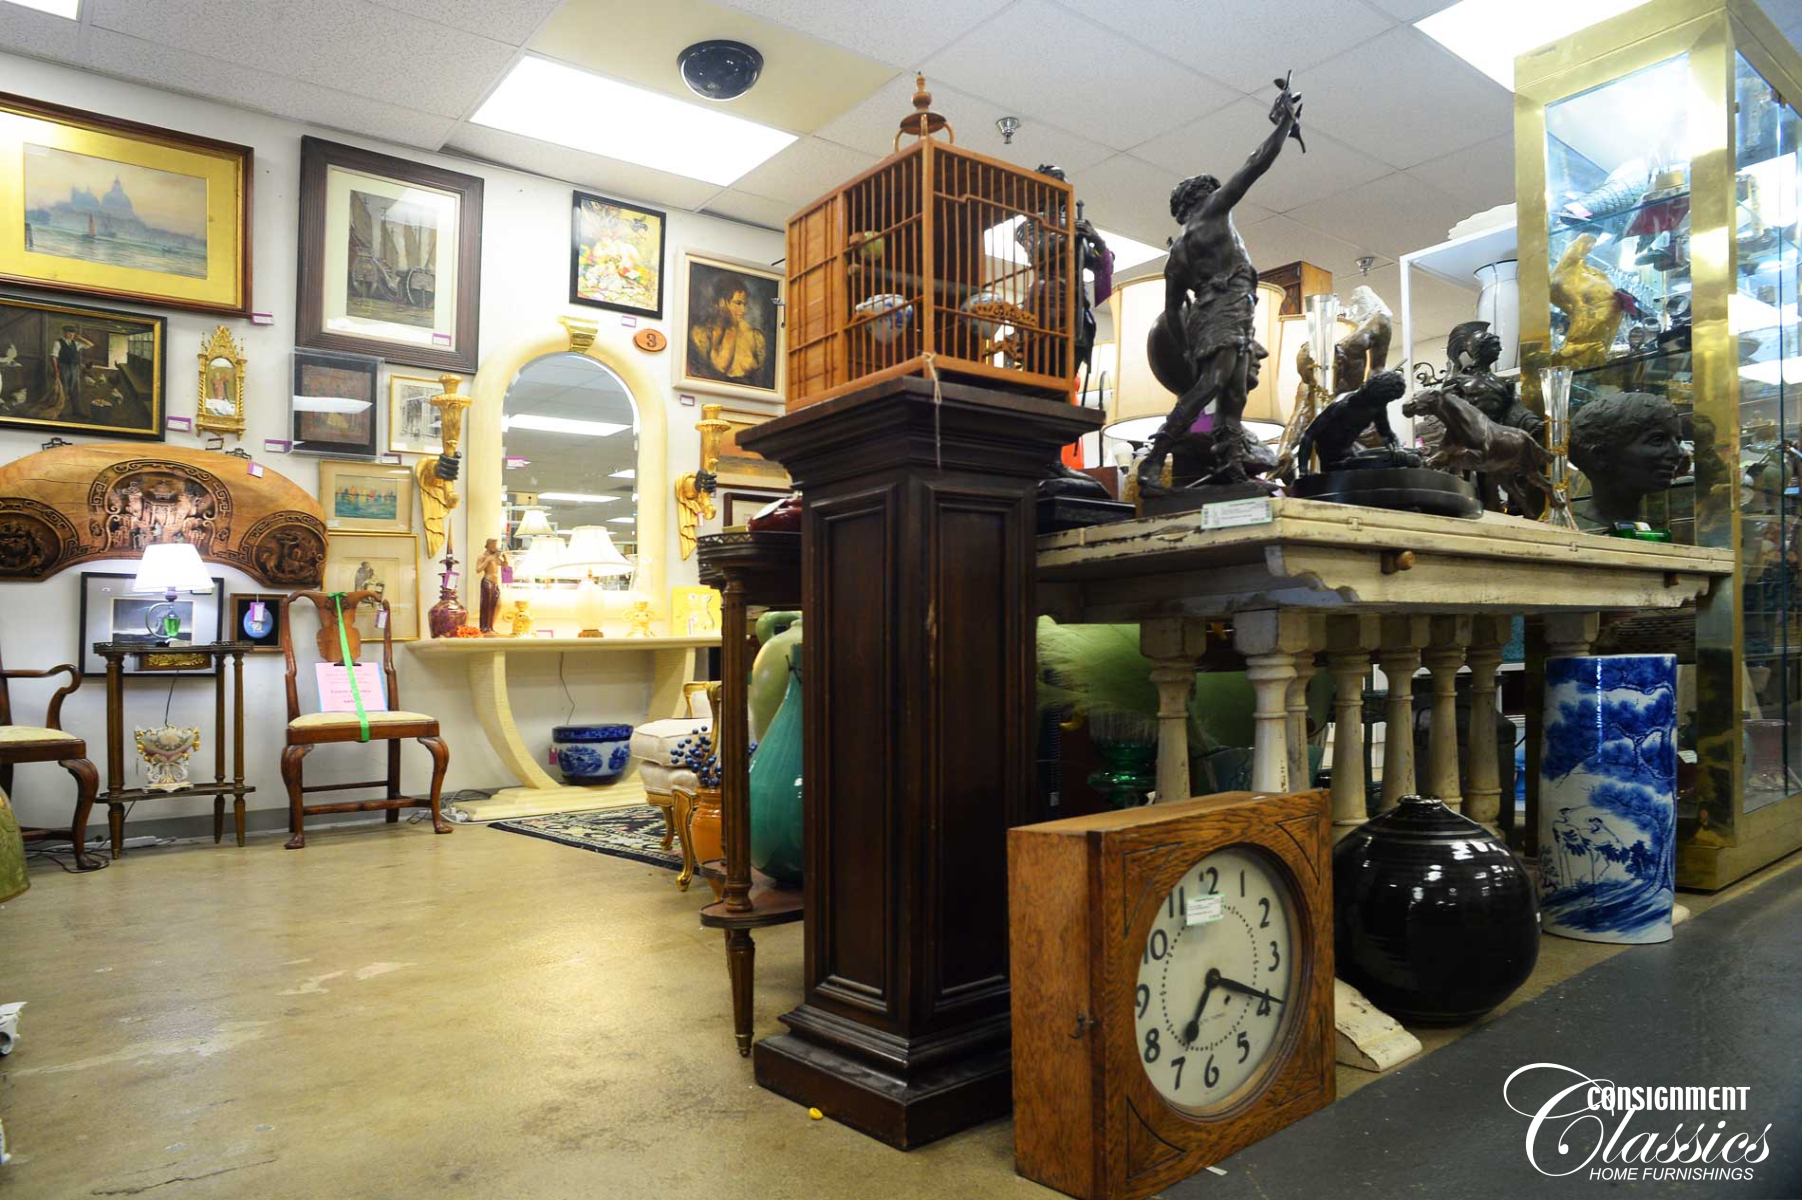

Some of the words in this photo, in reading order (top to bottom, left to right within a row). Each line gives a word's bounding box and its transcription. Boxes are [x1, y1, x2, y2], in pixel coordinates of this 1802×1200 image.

[646, 333, 657, 348] 3
[1240, 870, 1245, 897] 1
[1168, 885, 1185, 918] 11
[1259, 897, 1270, 929] 2
[1268, 940, 1280, 972] 3
[1135, 984, 1150, 1019] 9
[1256, 988, 1271, 1016] 4
[1144, 1028, 1161, 1063] 8
[1237, 1031, 1250, 1064] 5
[1170, 1056, 1186, 1091] 7
[1204, 1054, 1219, 1088] 6
